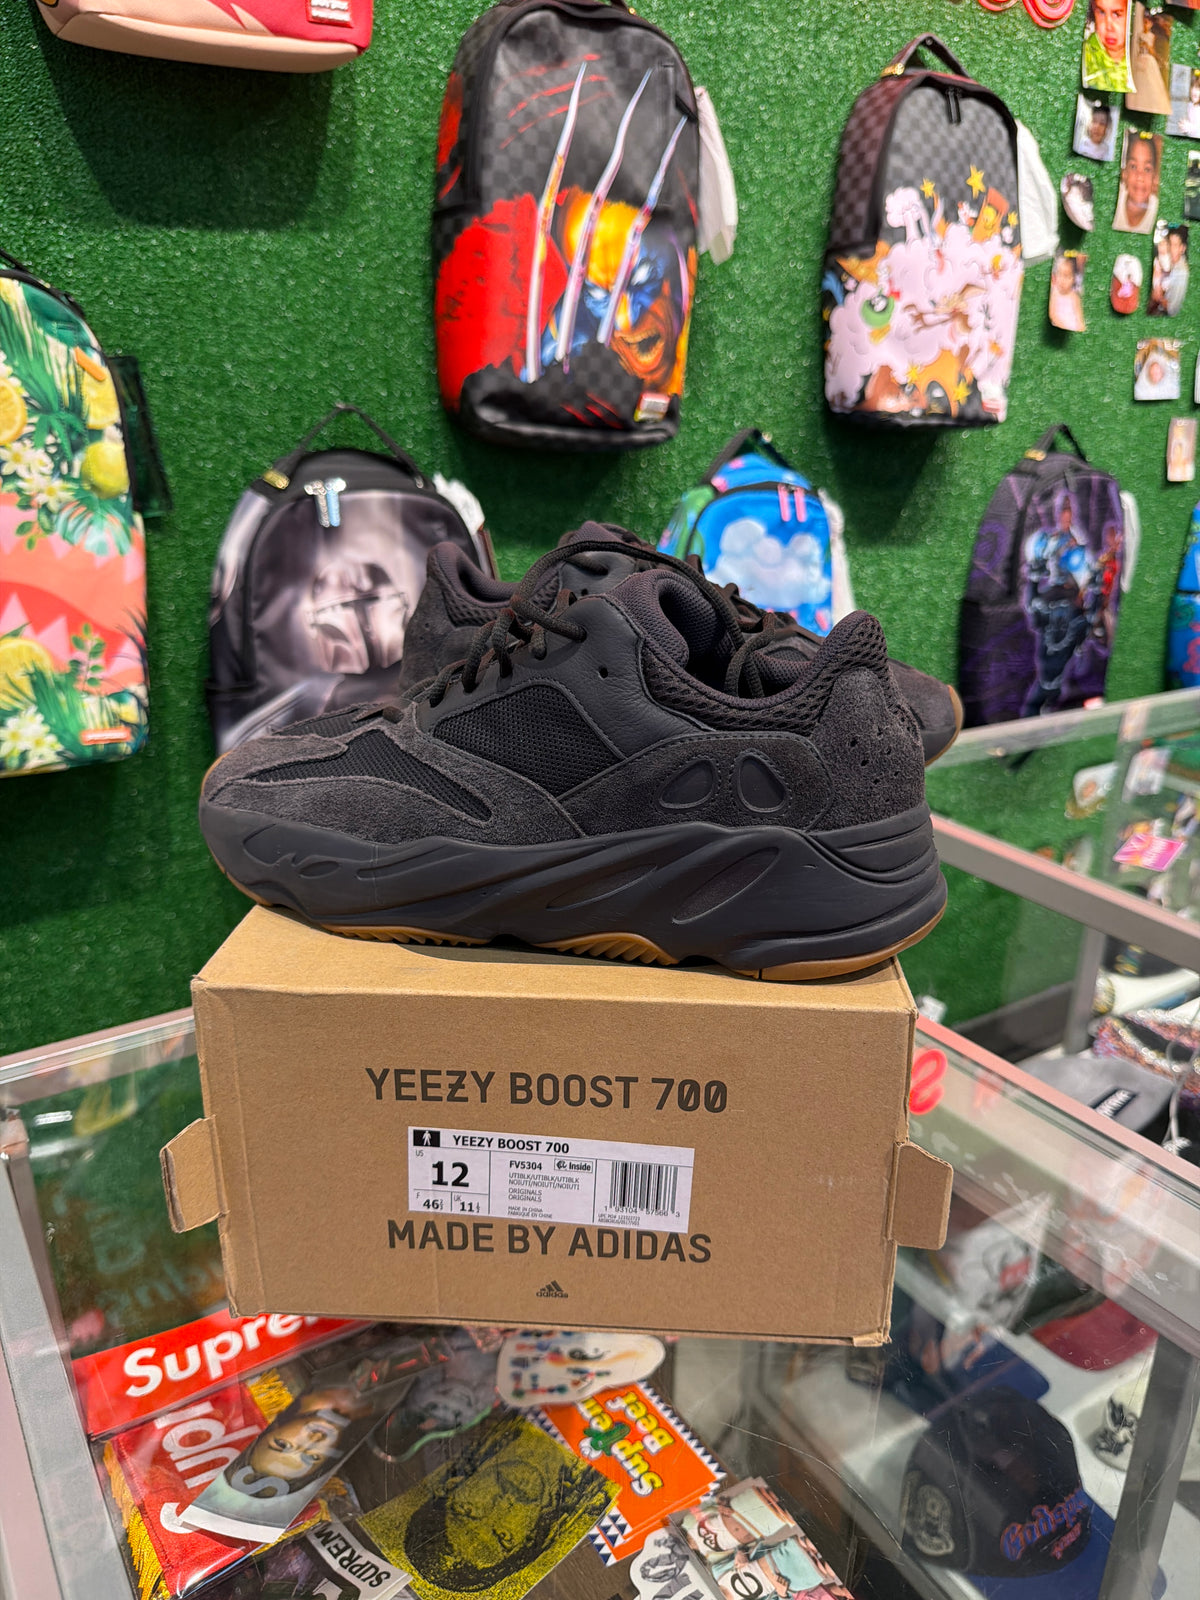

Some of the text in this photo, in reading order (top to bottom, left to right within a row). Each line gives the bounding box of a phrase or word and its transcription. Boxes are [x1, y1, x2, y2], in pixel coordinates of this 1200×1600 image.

[365, 1067, 728, 1113] YEEZY BOOST 700
[453, 1134, 570, 1154] YEEZY BOOST 700
[415, 1149, 424, 1157] US
[509, 1160, 543, 1171] FV5304
[568, 1161, 592, 1171] Inside
[431, 1160, 470, 1188] 12
[508, 1172, 580, 1184] UTIBLK/UTIBLK/UTIBLK
[508, 1188, 542, 1196] ORIGINALS
[453, 1194, 462, 1202] UK
[508, 1194, 542, 1202] ORIGINALS
[614, 1206, 638, 1214] 93104
[387, 1219, 712, 1264] MADE BY ADIDAS
[605, 1391, 676, 1455] Beef
